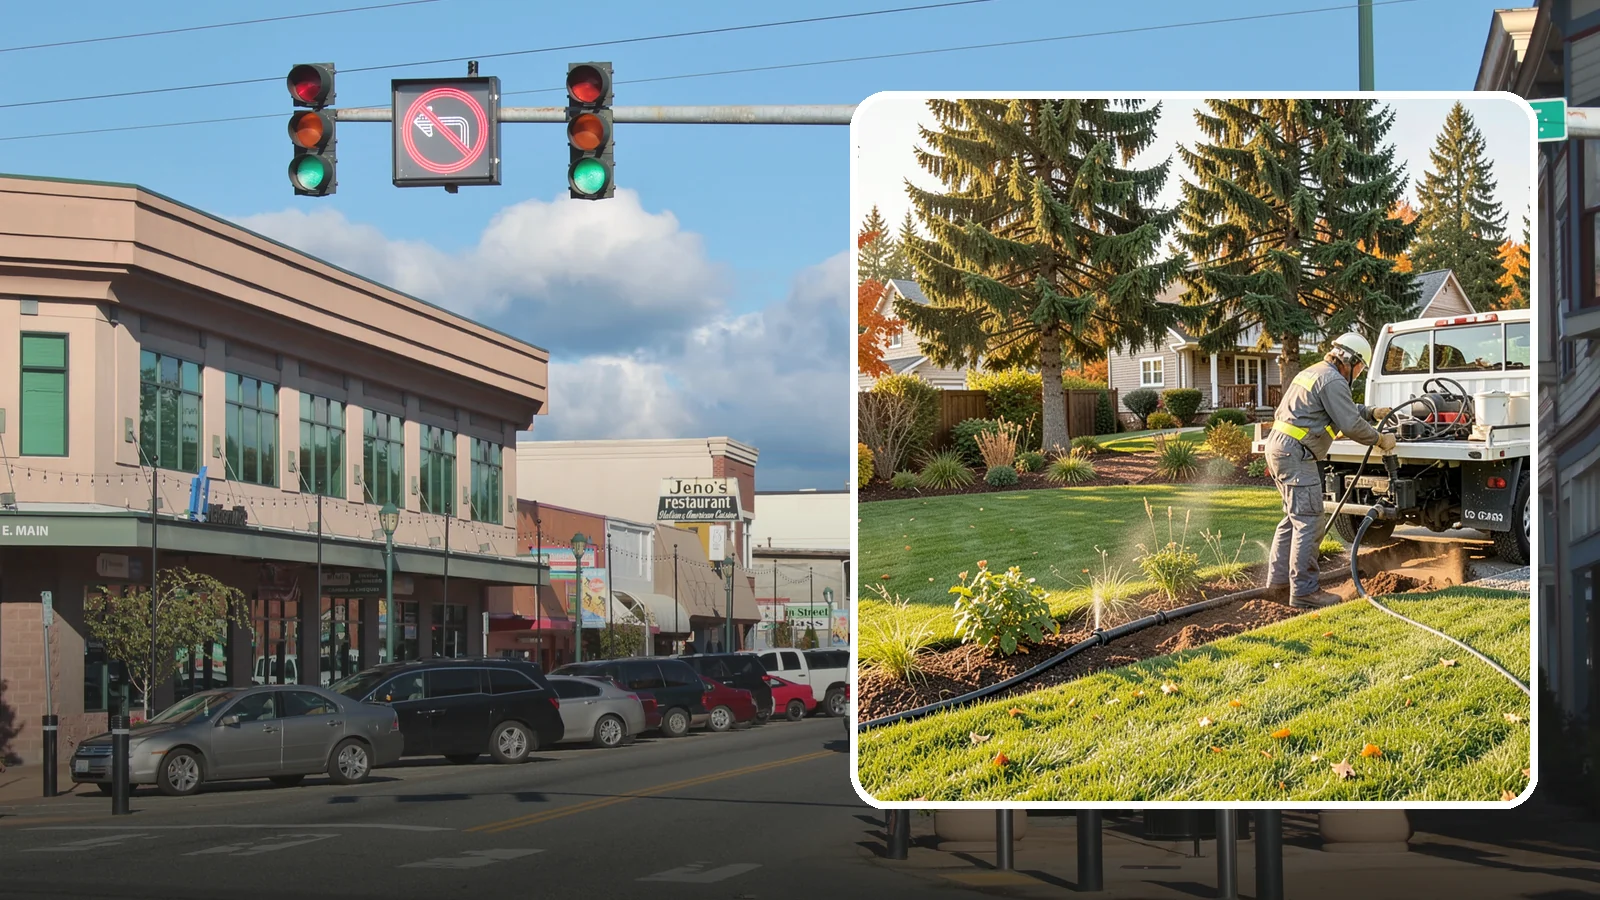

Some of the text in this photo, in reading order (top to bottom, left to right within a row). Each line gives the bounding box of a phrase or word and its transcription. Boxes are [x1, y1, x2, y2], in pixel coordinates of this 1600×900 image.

[669, 480, 728, 494] Jeno's
[665, 496, 731, 509] restaurant
[658, 510, 682, 519] Italian
[686, 510, 714, 519] American
[715, 510, 737, 519] Cuisine
[2, 525, 49, 536] E. MAIN
[797, 607, 828, 617] Street
